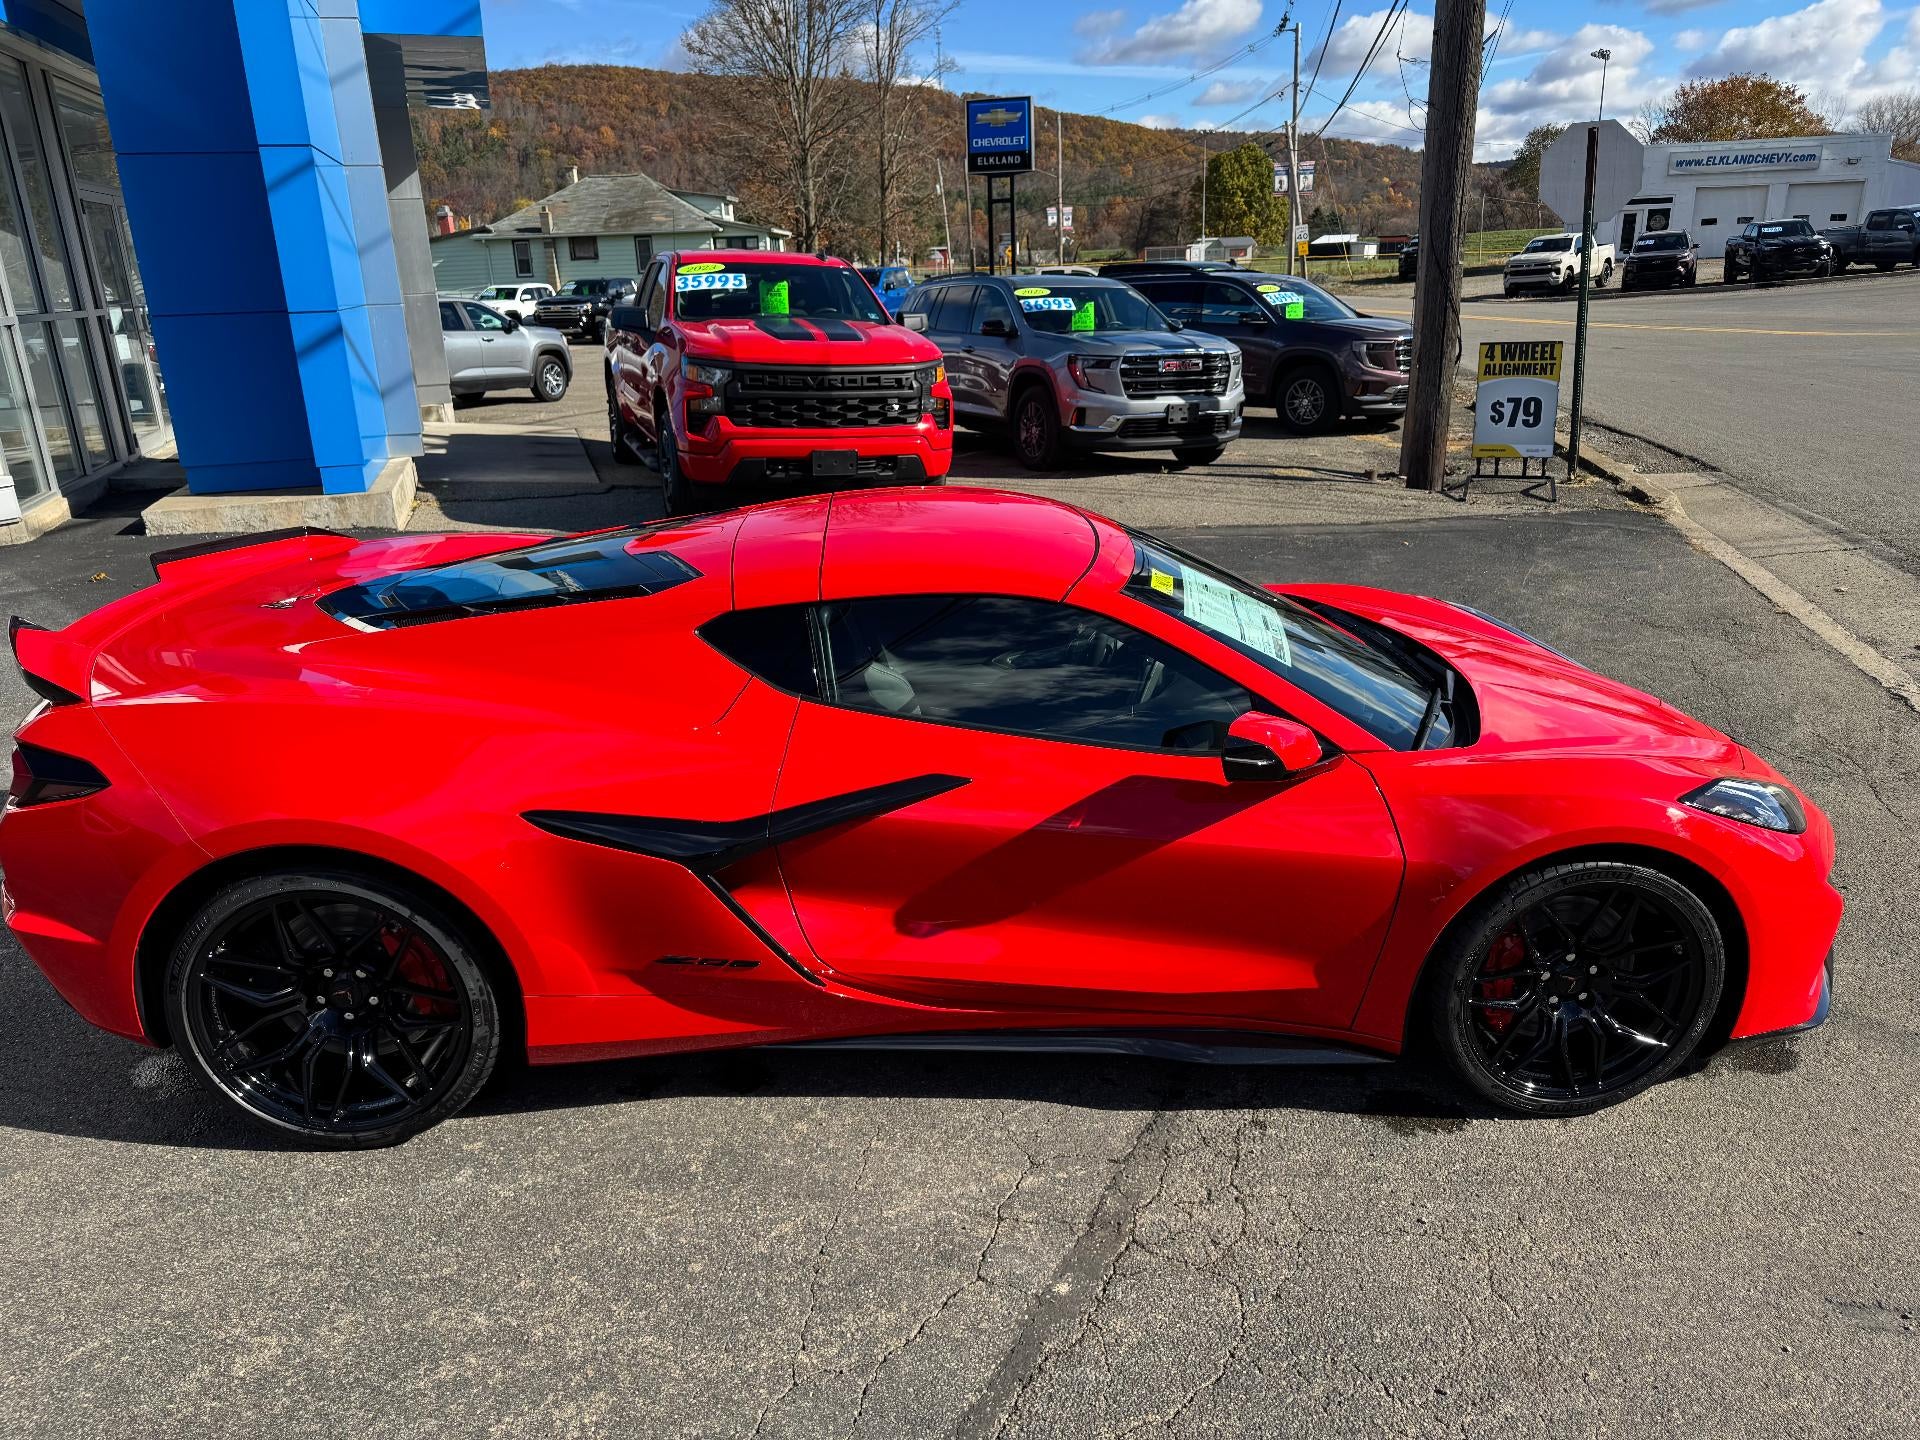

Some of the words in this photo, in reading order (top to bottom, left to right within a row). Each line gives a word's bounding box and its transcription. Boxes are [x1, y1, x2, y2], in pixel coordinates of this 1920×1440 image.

[973, 136, 1025, 147] CHEVROLET
[977, 155, 1021, 165] ELKLAND
[1675, 152, 1816, 168] www.ELKLANDCHEVY.com
[677, 274, 744, 290] 35995
[1023, 298, 1072, 311] 36995
[1485, 343, 1495, 361] 4
[1500, 343, 1557, 361] WHEEL
[1163, 360, 1202, 371] GMC
[1483, 363, 1556, 376] ALIGNMENT
[743, 373, 914, 389] CHEVROLET
[1489, 397, 1543, 428] $79
